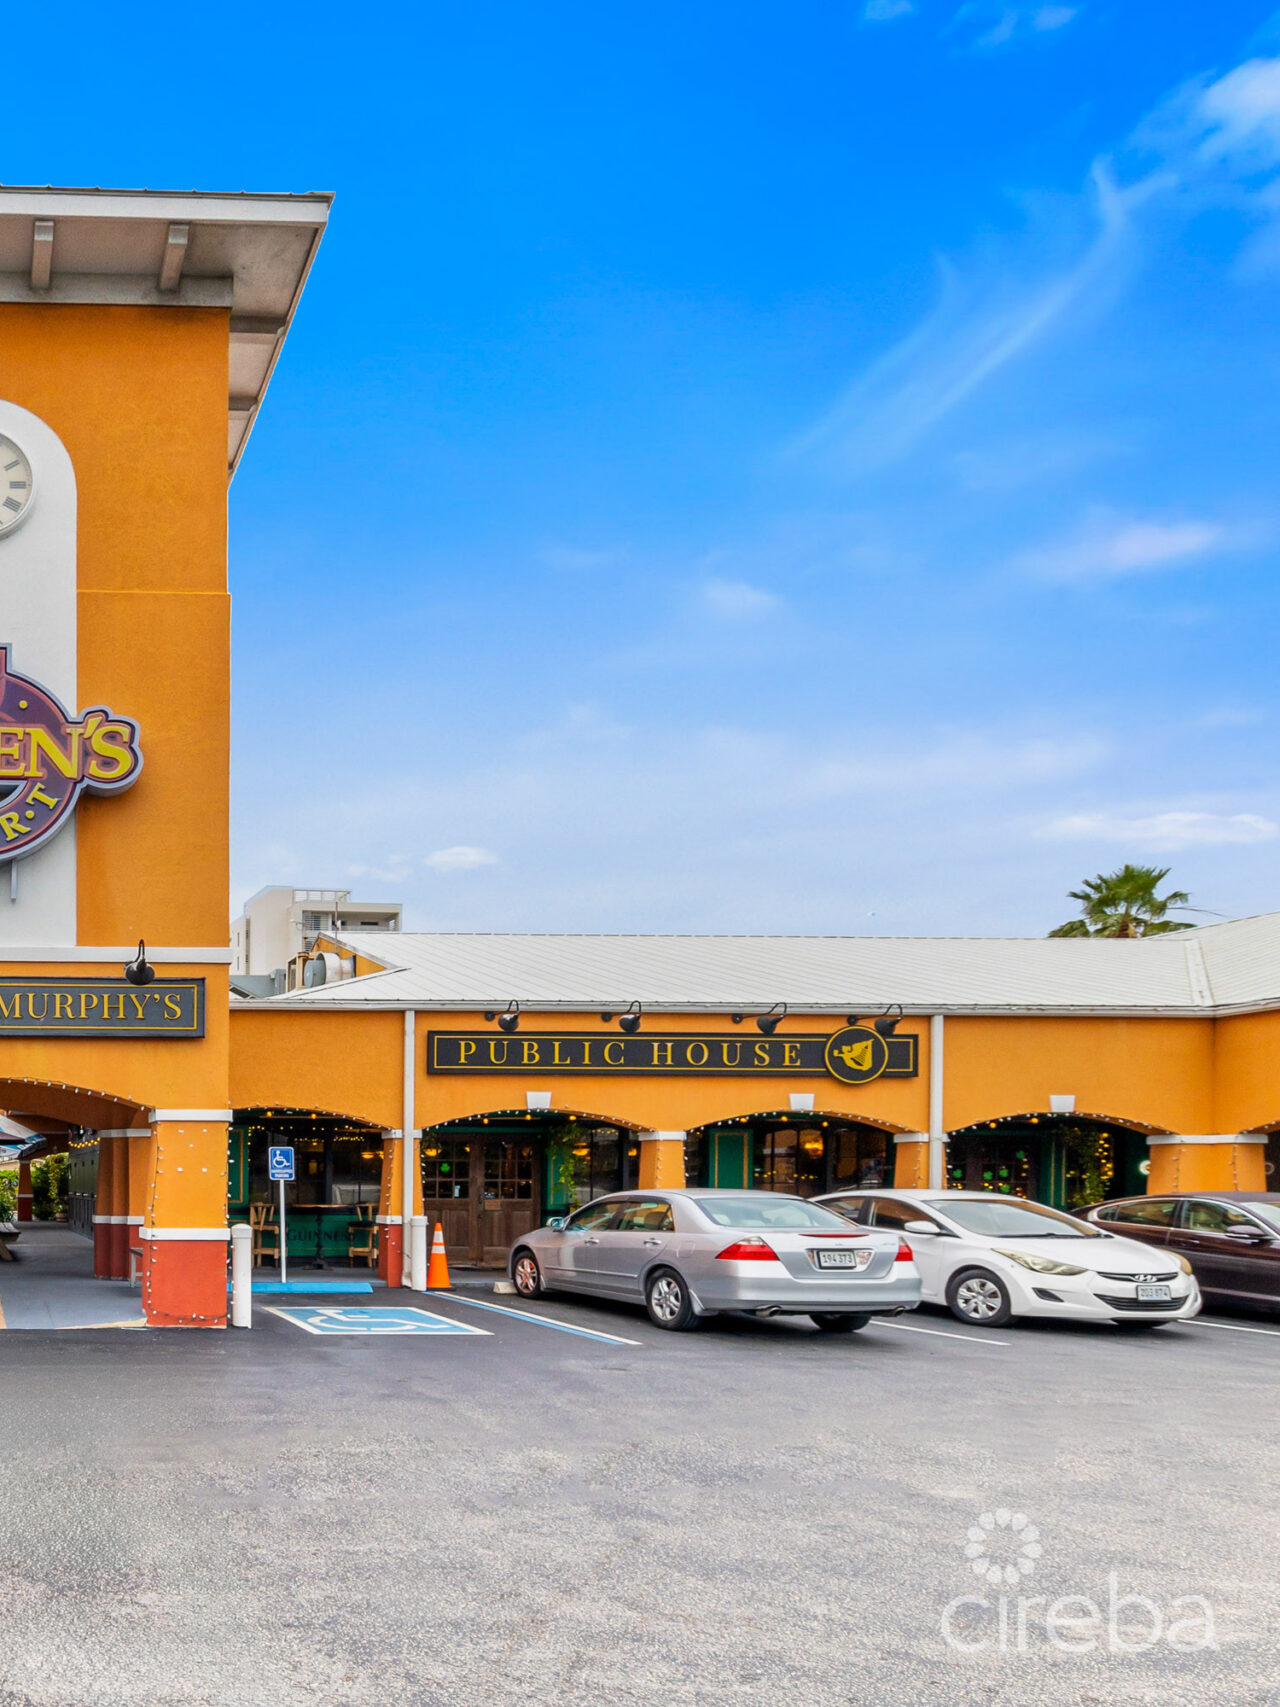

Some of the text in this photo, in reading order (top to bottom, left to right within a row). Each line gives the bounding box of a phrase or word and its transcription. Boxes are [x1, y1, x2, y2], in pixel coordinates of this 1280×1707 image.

[458, 1039, 802, 1068] PUBLIC HOUSE
[287, 1229, 353, 1242] GUINNES
